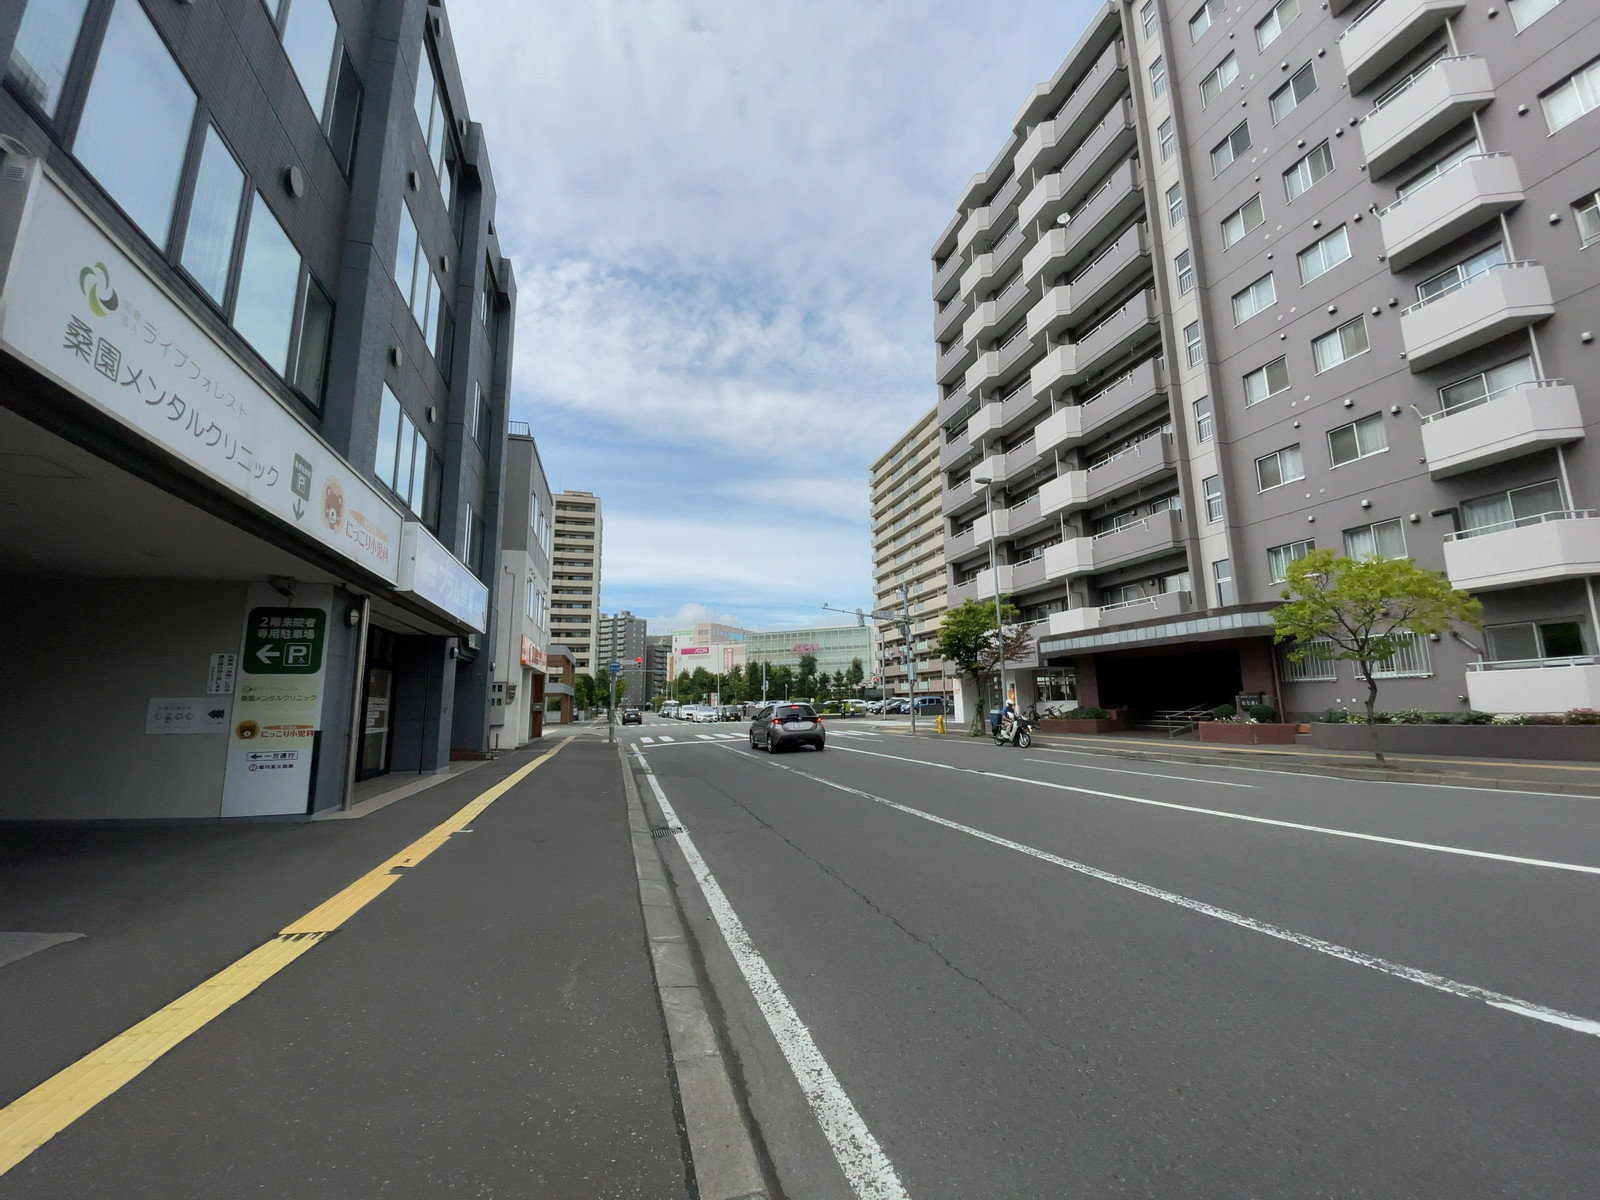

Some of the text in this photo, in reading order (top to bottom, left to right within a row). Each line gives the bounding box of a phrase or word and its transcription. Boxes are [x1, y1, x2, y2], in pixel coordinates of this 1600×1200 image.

[143, 322, 248, 418] ライフフォレスト
[63, 314, 279, 487] 桑園メンタルクリニック
[345, 521, 390, 564] にっこり小児科
[257, 628, 315, 640] 専用駐車場
[288, 646, 307, 664] P
